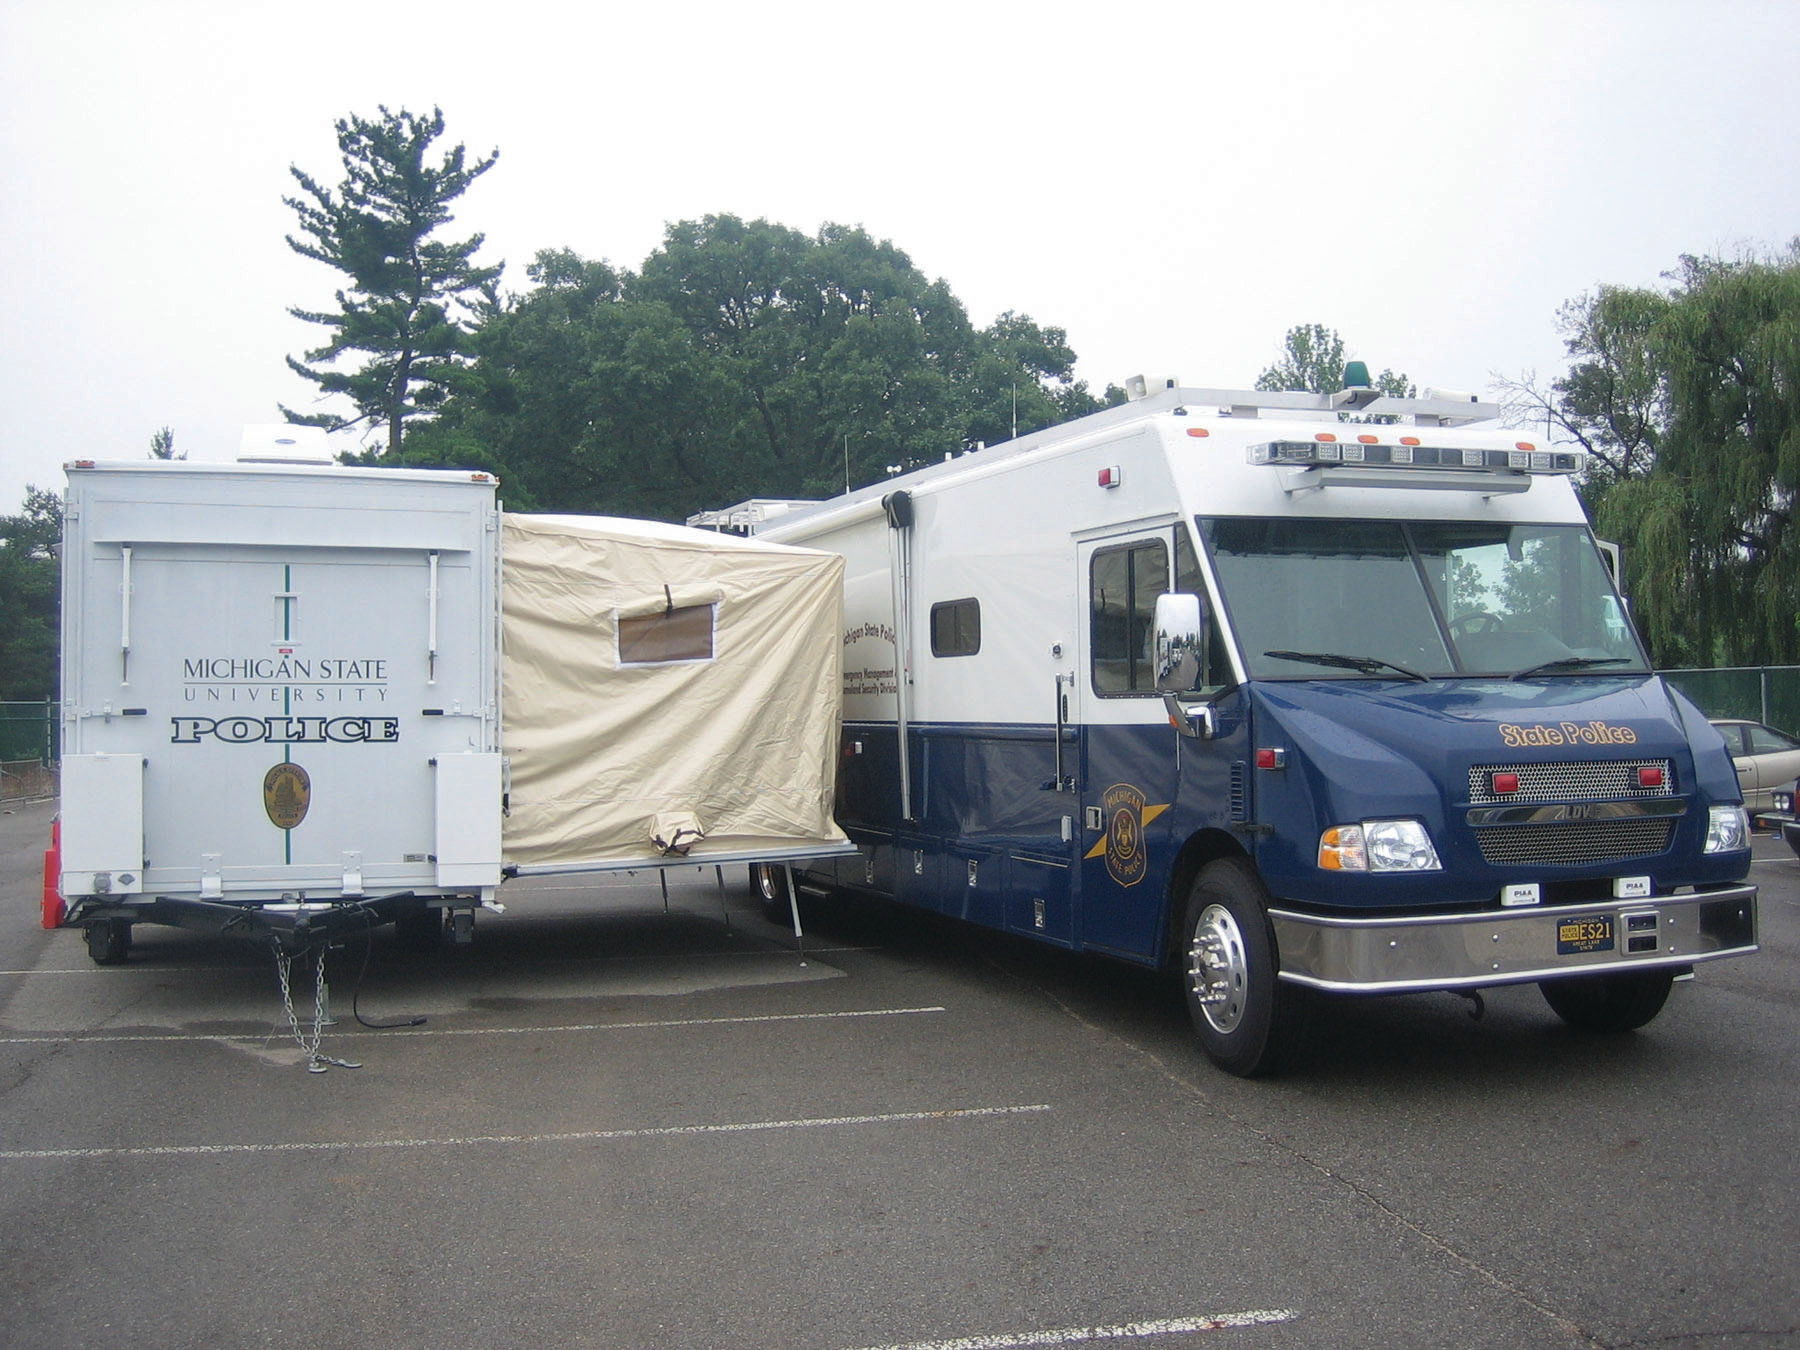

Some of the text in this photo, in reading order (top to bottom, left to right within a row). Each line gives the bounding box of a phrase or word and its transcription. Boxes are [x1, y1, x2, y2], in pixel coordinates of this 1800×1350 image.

[843, 622, 895, 647] ichigan State Polic
[183, 658, 388, 679] MICHIGAN STATE
[184, 687, 388, 702] UNIVERSITY
[171, 716, 399, 743] POLICE
[1499, 721, 1637, 747] State Police
[1107, 790, 1141, 811] MICHIGAN
[1579, 922, 1610, 940] ES21
